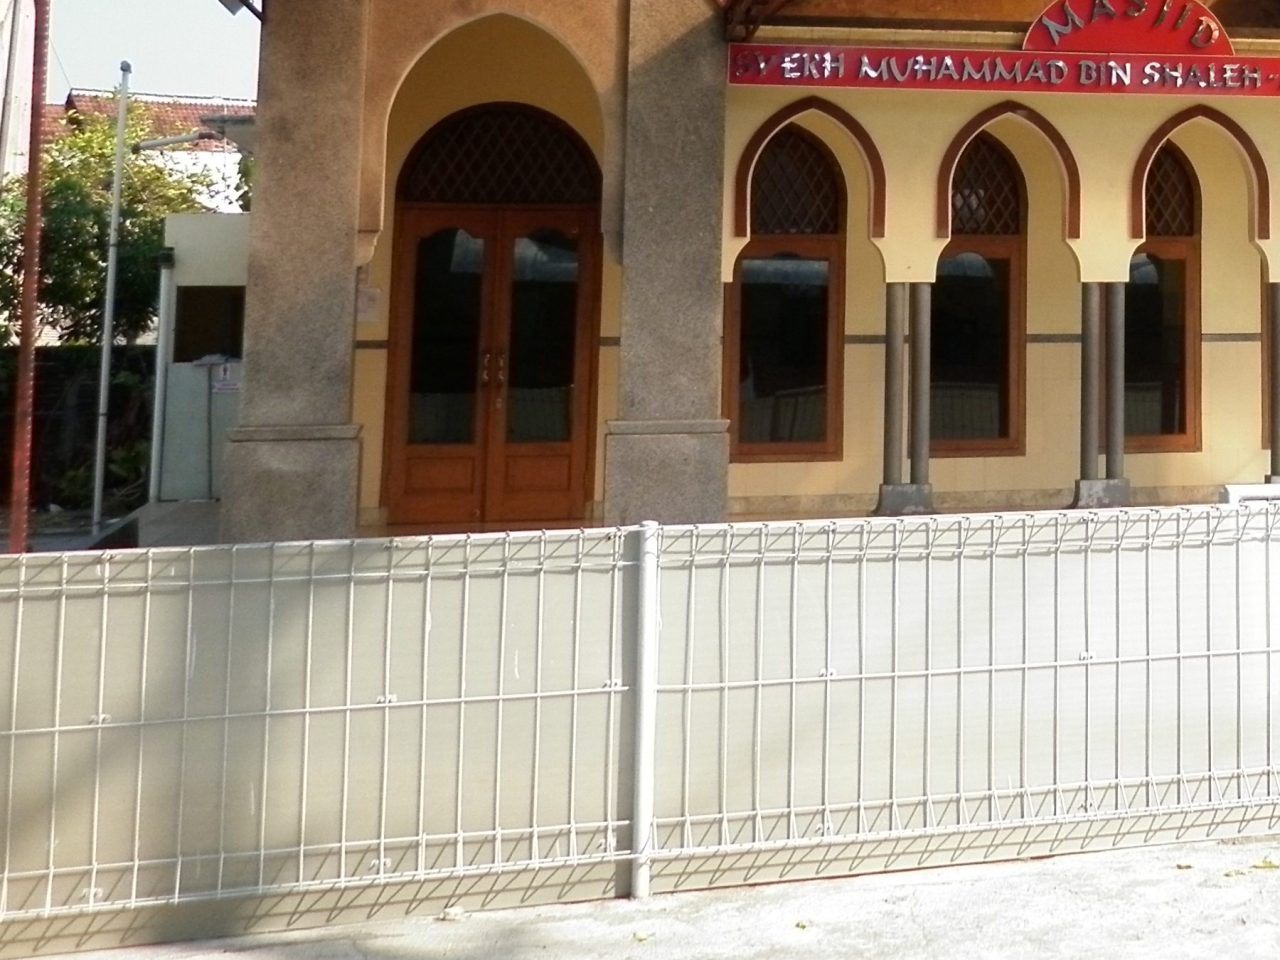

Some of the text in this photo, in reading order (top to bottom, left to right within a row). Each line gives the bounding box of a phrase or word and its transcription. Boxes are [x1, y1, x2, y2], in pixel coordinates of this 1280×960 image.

[735, 50, 845, 79] SYEKH
[858, 54, 1069, 85] MUHAMMAD
[1078, 60, 1131, 86] BIN
